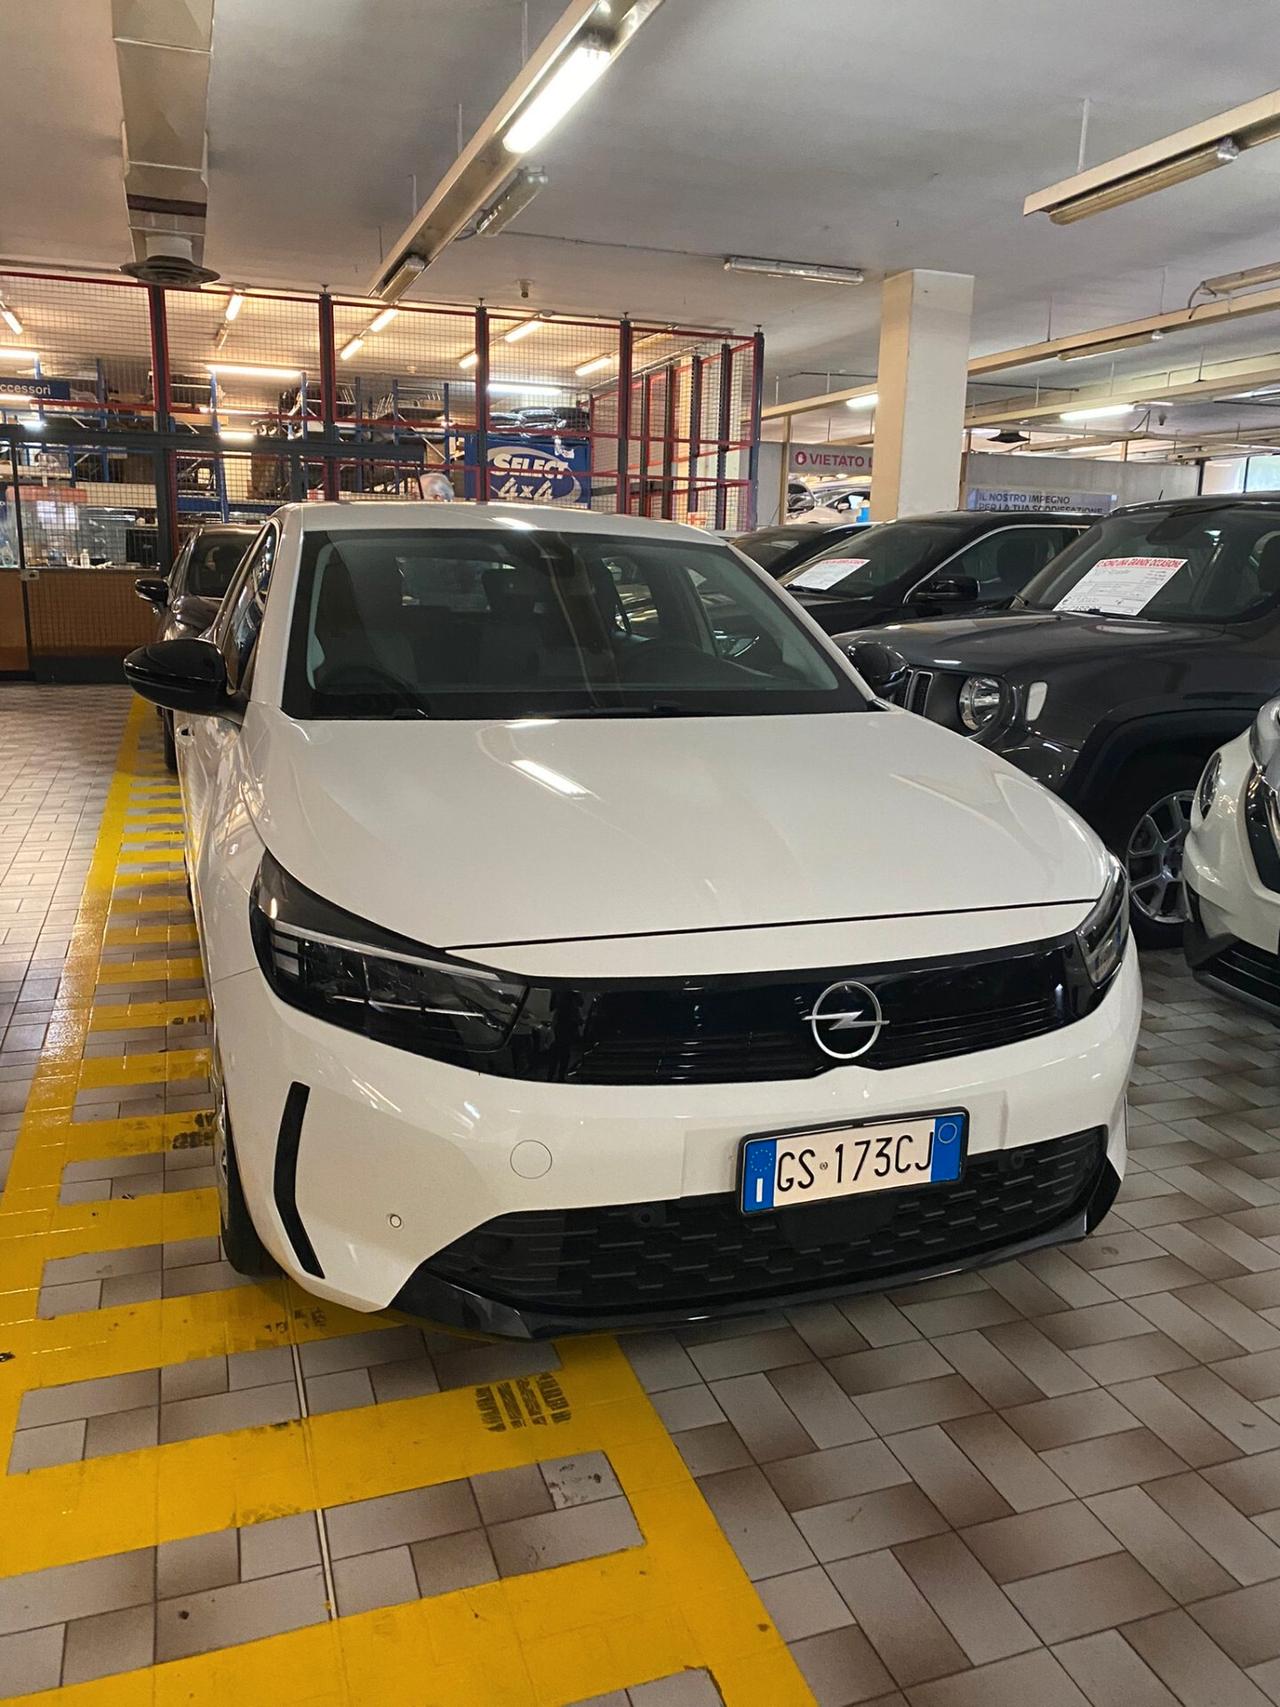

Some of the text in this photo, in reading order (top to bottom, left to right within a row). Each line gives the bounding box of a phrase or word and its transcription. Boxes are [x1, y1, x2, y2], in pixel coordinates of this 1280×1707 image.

[490, 453, 568, 479] SELECT
[810, 453, 865, 467] VIETATO
[498, 477, 553, 500] 4x4
[979, 493, 1071, 504] IL NOSTRO IMPEGNO
[777, 1131, 934, 1192] GS 173CJ
